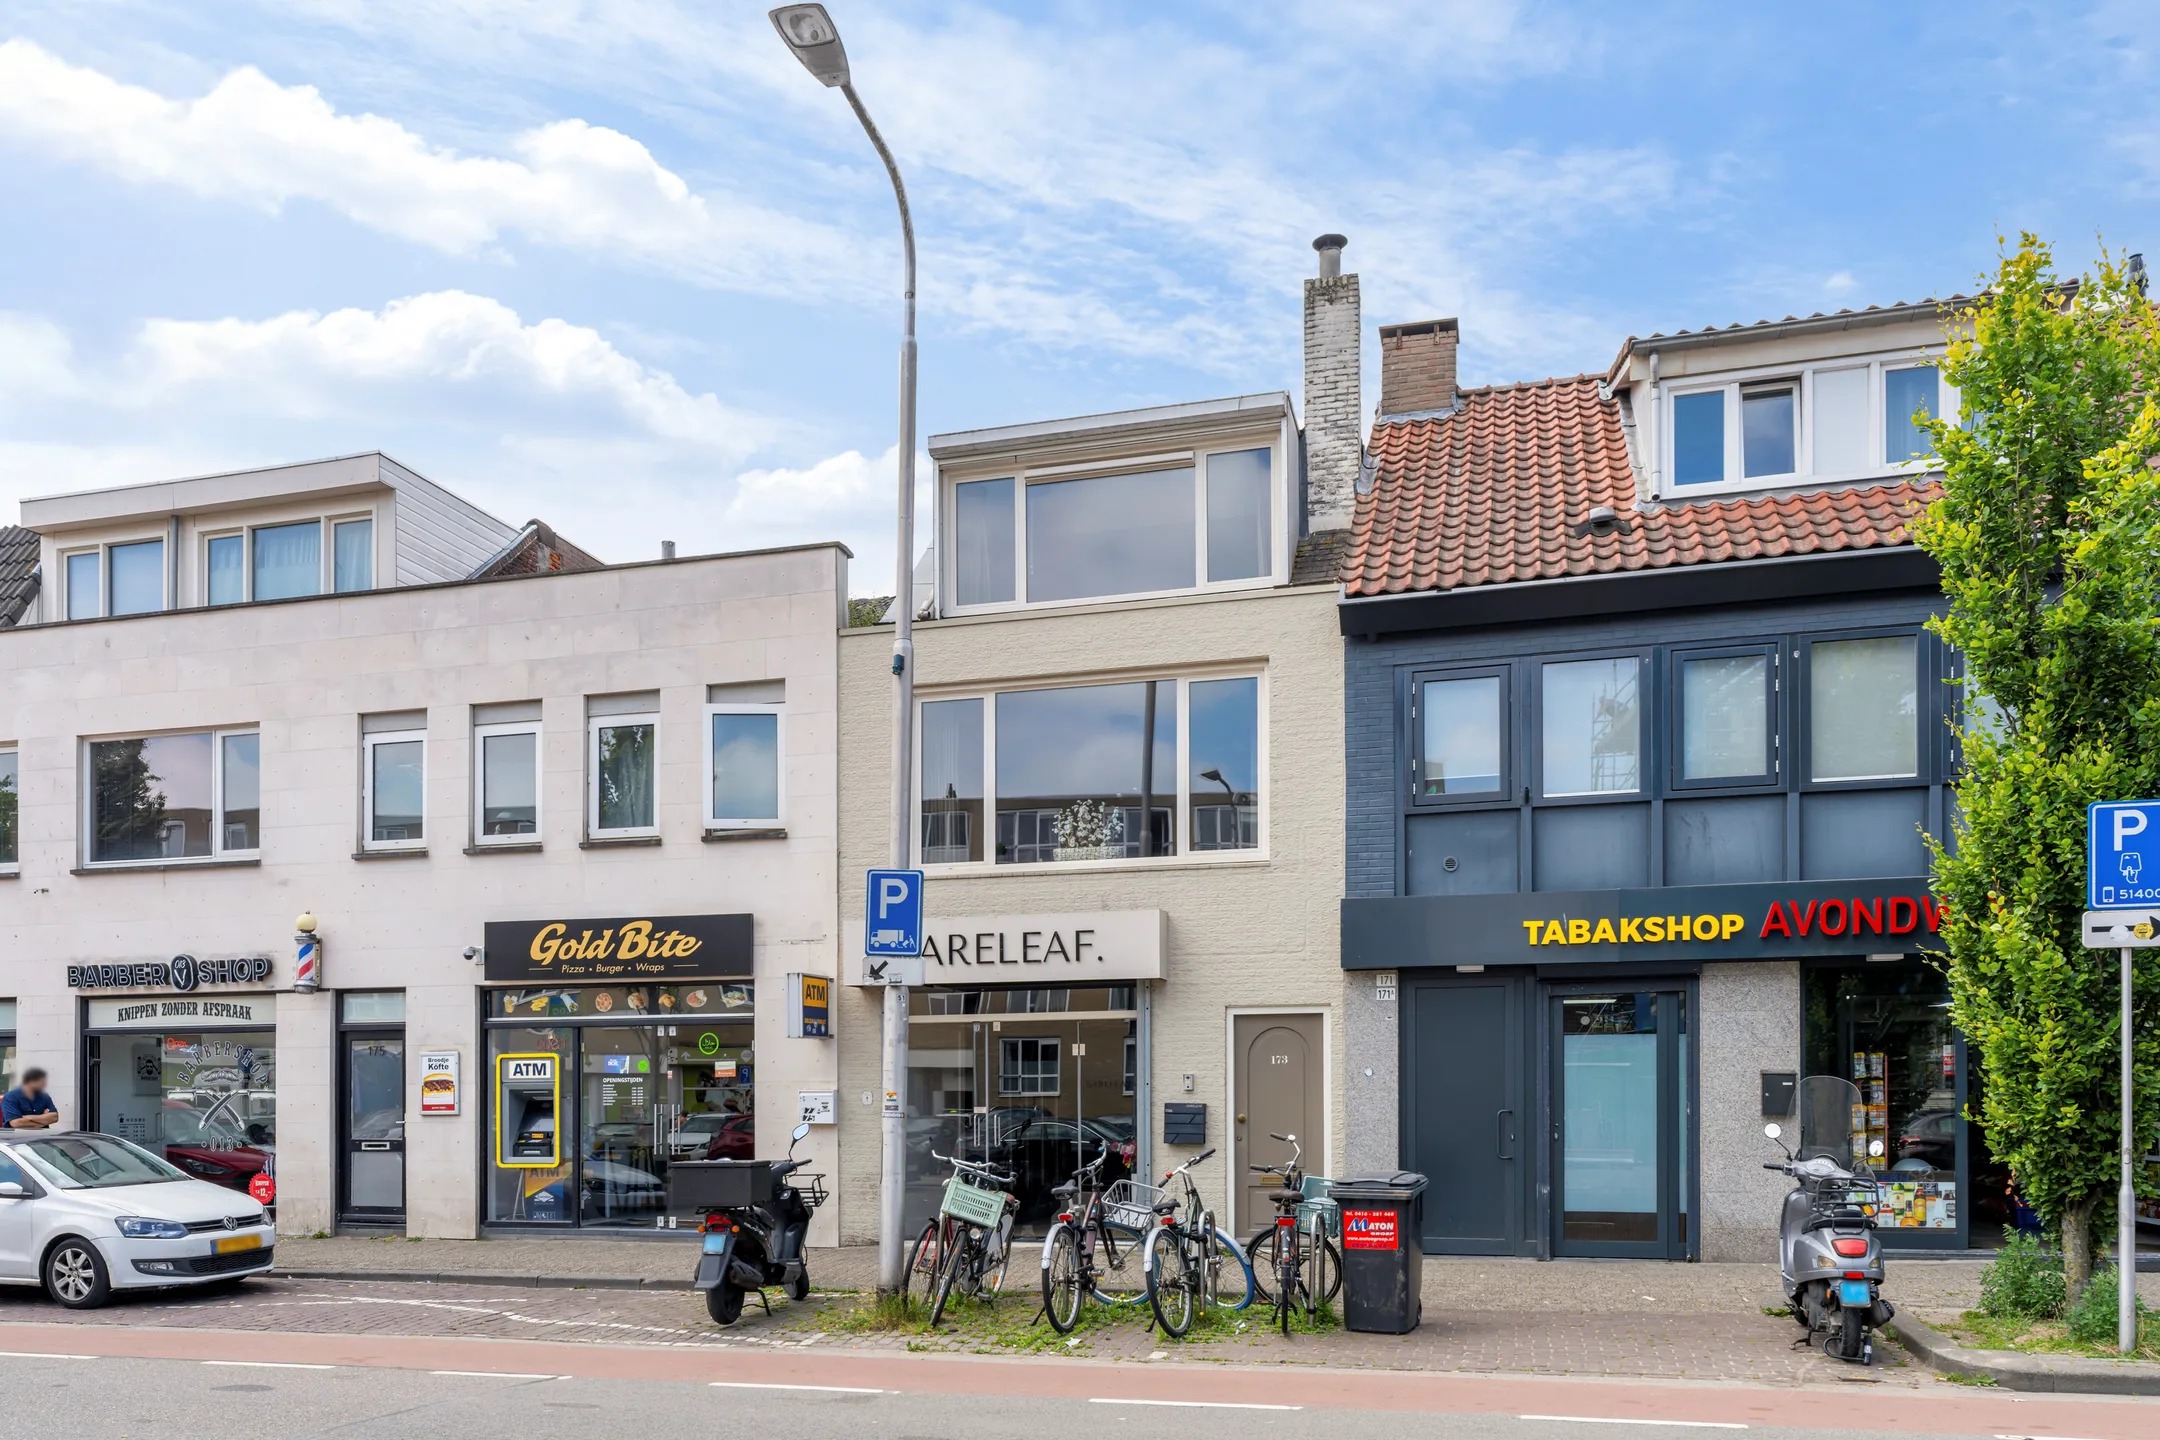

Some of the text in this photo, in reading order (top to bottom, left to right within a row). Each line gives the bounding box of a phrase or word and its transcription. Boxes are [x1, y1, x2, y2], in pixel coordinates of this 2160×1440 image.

[2114, 809, 2148, 851] P
[879, 878, 908, 919] P
[1523, 896, 1952, 945] TABAKSHOP AVONDW
[530, 920, 702, 966] Gold Bite
[921, 929, 1104, 966] ARELEAF.
[67, 958, 272, 988] BARBER SHOP
[561, 962, 665, 975] Pizza Burger Wraps
[1380, 975, 1393, 985] 171
[805, 984, 825, 1001] ATM
[117, 1002, 252, 1022] KNIPPEN ZONDER AFSPRAAK
[368, 1046, 386, 1056] 175
[1271, 1055, 1288, 1064] 173
[177, 1041, 269, 1084] BARBERSHOP
[513, 1063, 546, 1076] ATM
[210, 1136, 234, 1152] 013
[1346, 1218, 1394, 1231] MATON
